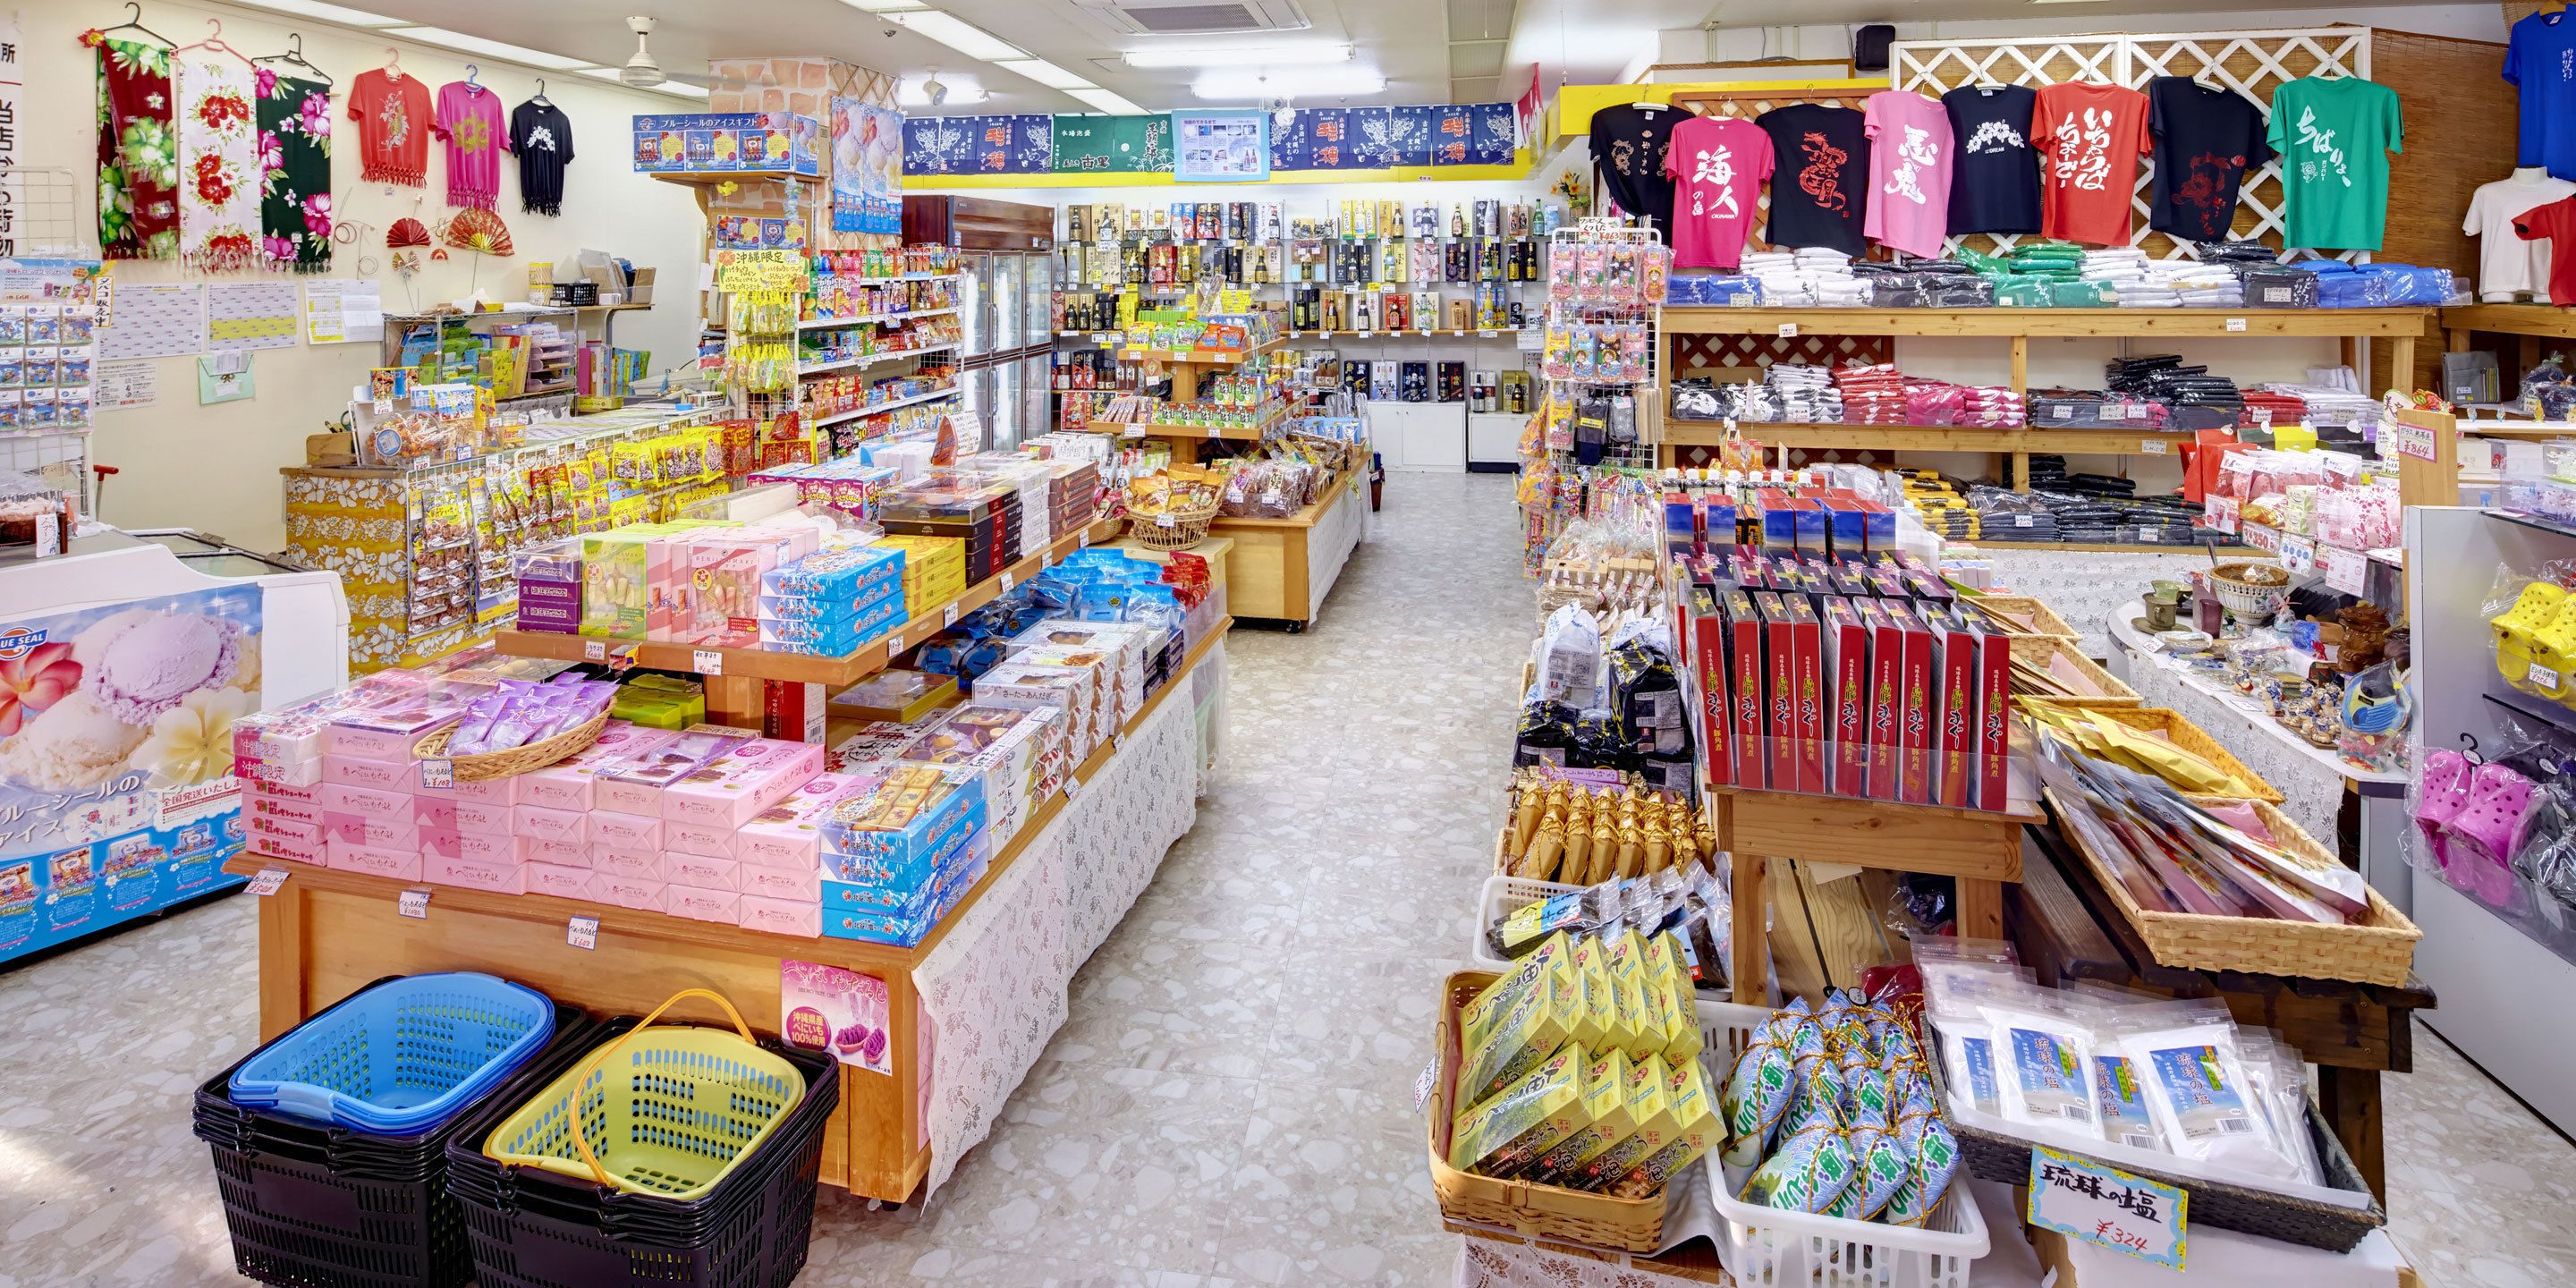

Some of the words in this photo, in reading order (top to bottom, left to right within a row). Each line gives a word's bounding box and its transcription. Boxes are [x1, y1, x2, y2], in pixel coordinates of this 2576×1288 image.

[662, 117, 757, 129] ブルーシールのアイスギフト
[1692, 144, 1738, 217] 海人
[736, 251, 784, 265] 沖縄限定
[2404, 440, 2429, 457] ¥864
[18, 632, 43, 645] SEAL
[1002, 689, 1057, 700] さーたーあんだぎー
[242, 760, 285, 782] 沖縄限定
[0, 775, 140, 826] ルーシールの
[791, 1031, 826, 1047] 100%使用
[792, 1022, 824, 1037] べにいも
[2033, 1036, 2062, 1089] 琉球の塩
[2174, 1052, 2214, 1106] 琉球の塩
[2039, 1164, 2163, 1224] 琉球の塩
[2094, 1220, 2148, 1250] ¥324
